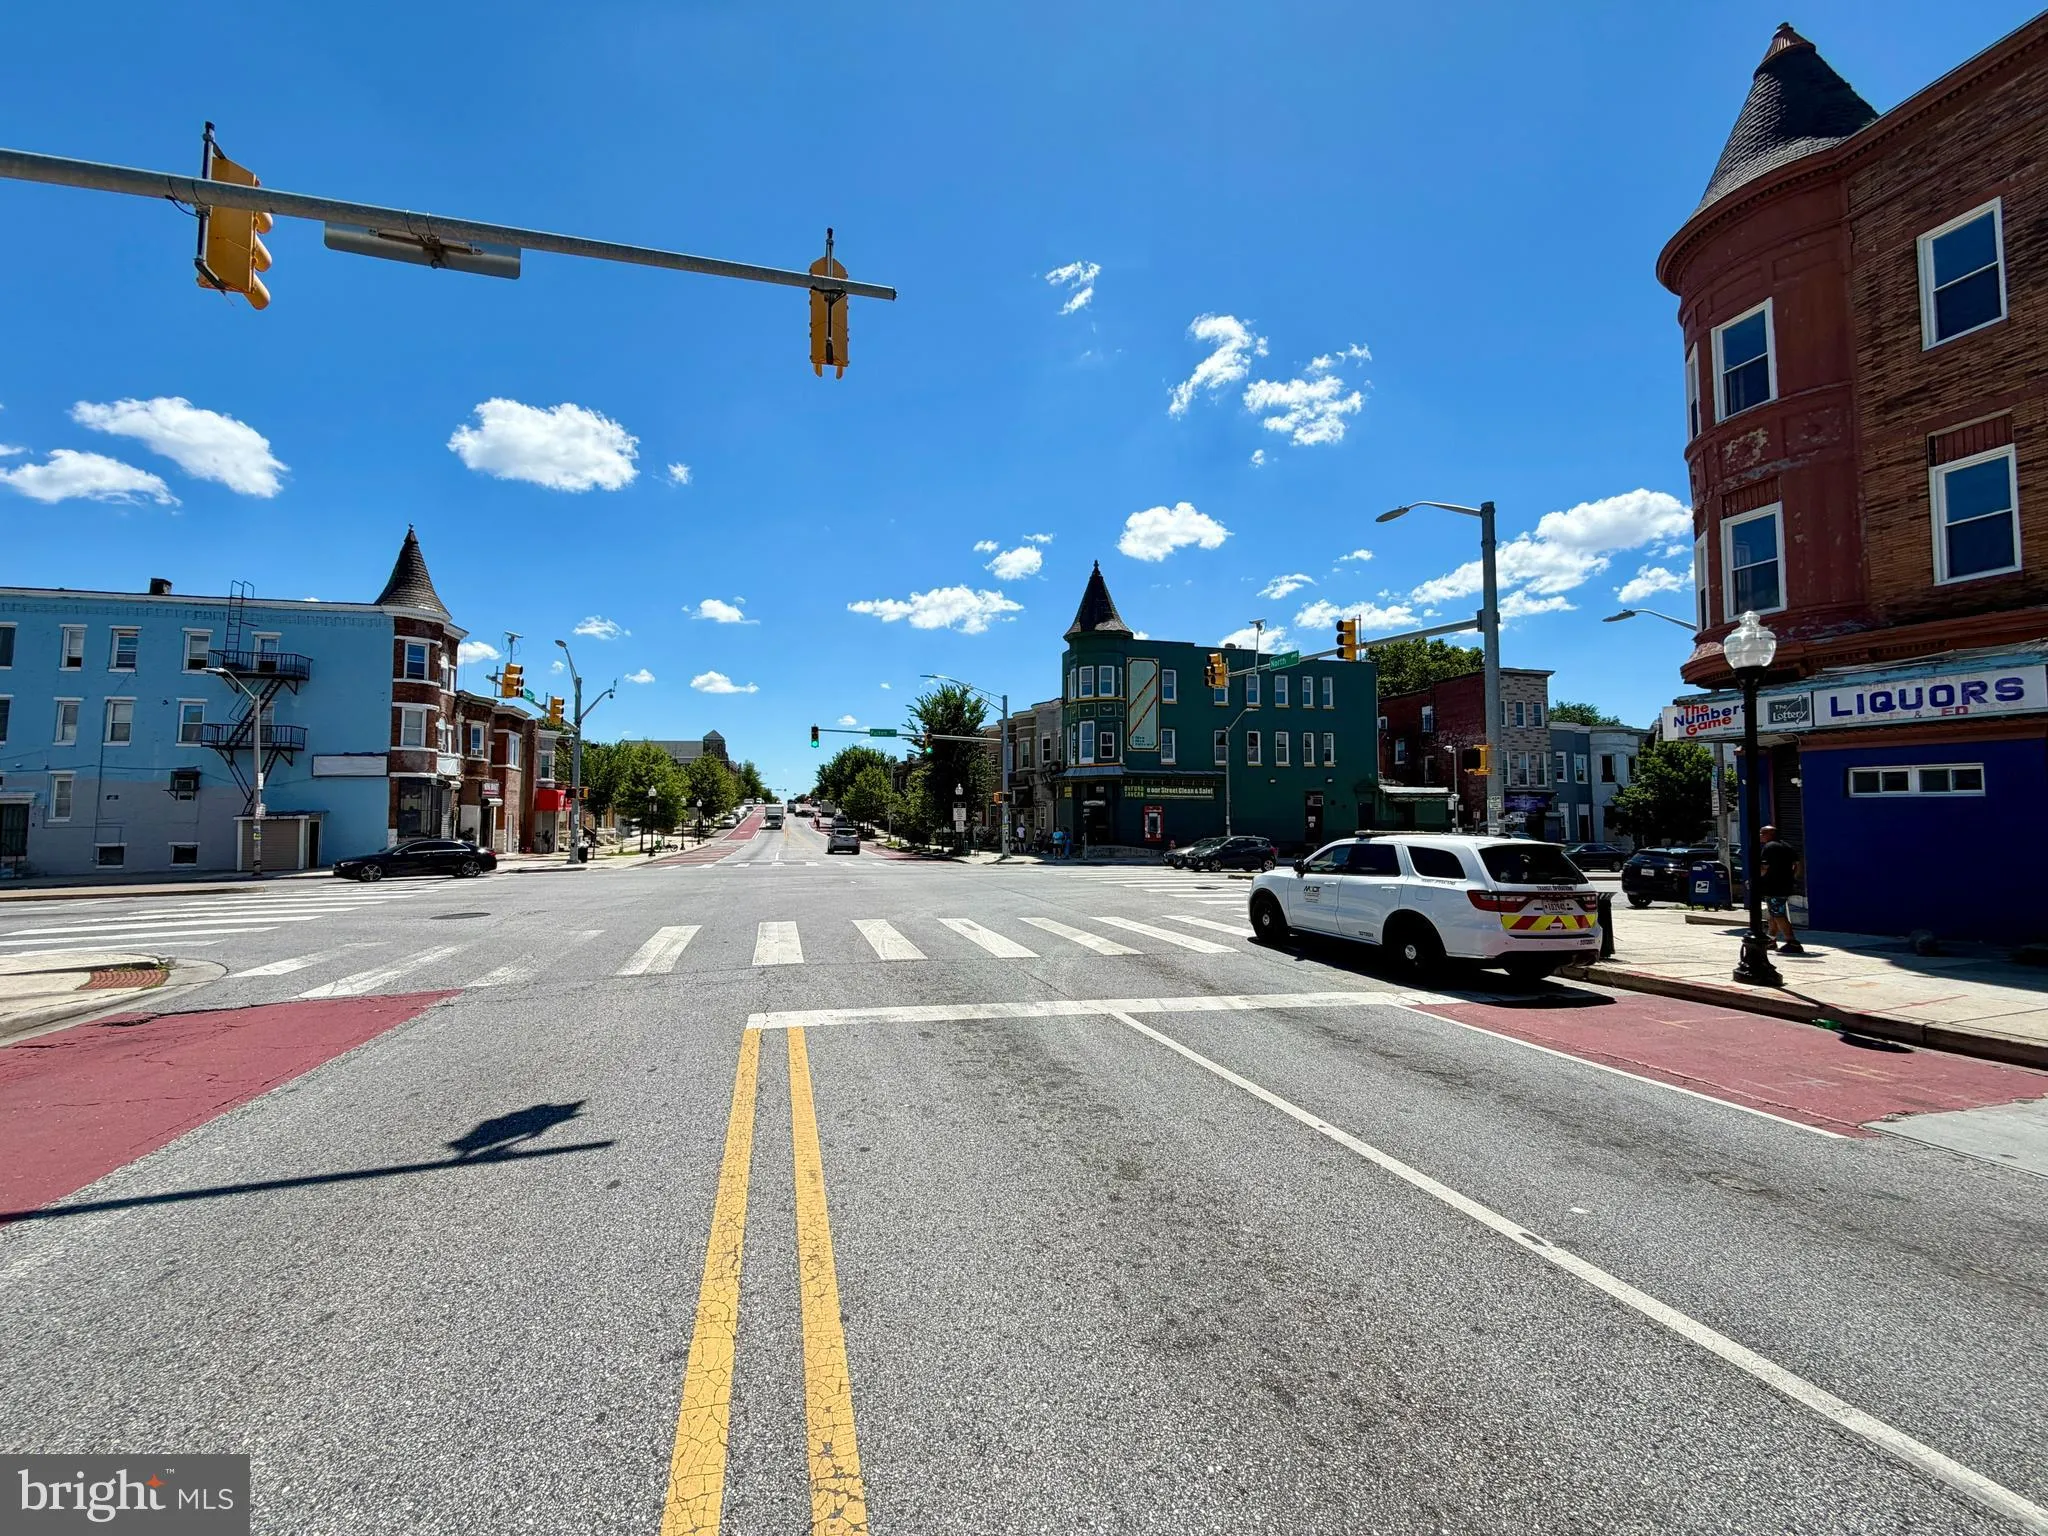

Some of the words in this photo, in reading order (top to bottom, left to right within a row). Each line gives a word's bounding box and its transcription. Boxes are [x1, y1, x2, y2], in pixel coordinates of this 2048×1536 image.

[1271, 658, 1287, 668] North
[1830, 677, 2025, 718] LIQUORS
[1683, 703, 1710, 719] The
[1773, 711, 1808, 722] Lottery
[1685, 716, 1732, 736] Game
